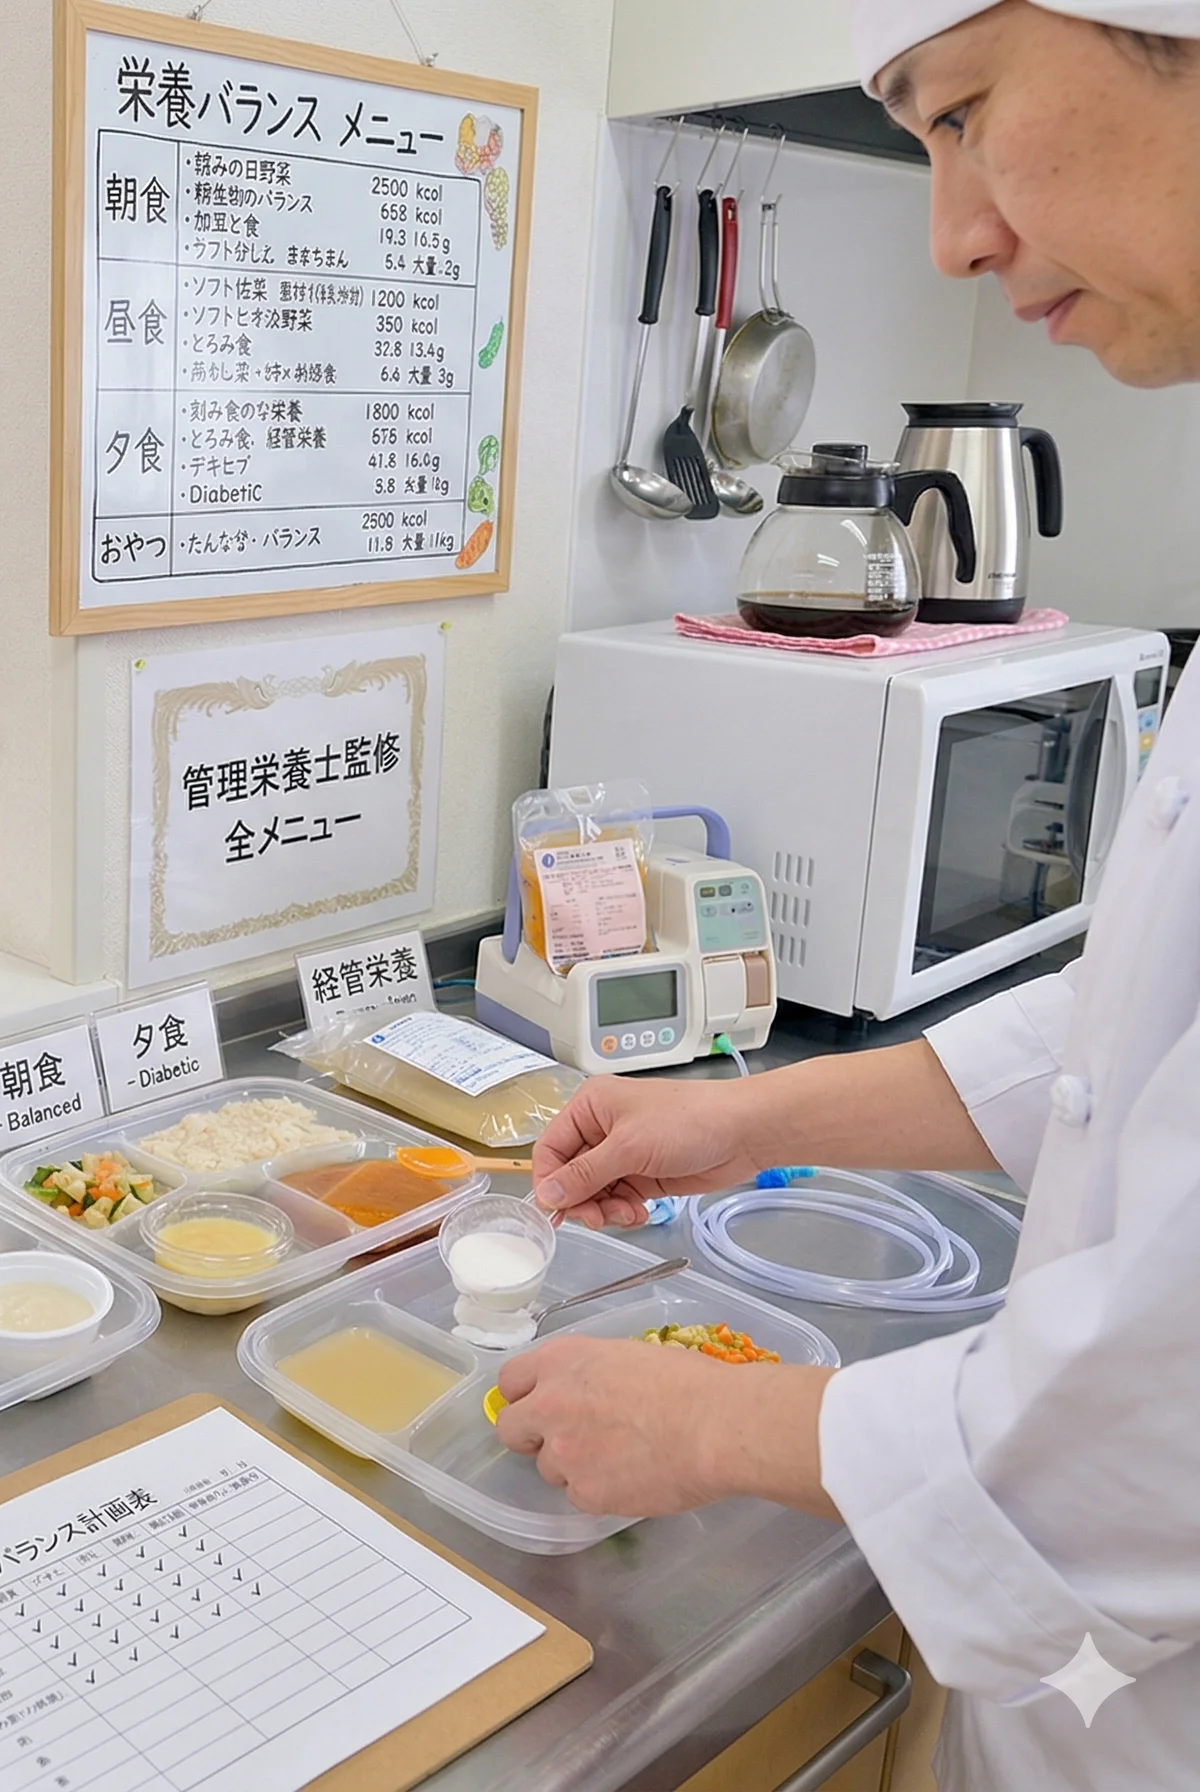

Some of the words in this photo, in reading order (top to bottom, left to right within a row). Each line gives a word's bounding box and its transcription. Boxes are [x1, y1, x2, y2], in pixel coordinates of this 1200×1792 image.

[117, 55, 321, 142] 栄養バランス
[340, 102, 444, 155] メニュー
[105, 172, 170, 225] 朝食
[372, 176, 408, 197] 2500
[381, 203, 407, 221] 658
[380, 228, 406, 246] 19.3
[372, 289, 405, 308] 1200
[105, 298, 168, 347] 昼食
[376, 315, 403, 333] 350
[374, 340, 402, 357] 32.8
[438, 367, 454, 388] 3g
[366, 402, 399, 420] 1800
[105, 426, 166, 475] 夕食
[368, 452, 396, 469] 41.8
[100, 531, 167, 565] おやつ
[182, 731, 401, 811] 管理栄養士監修
[224, 813, 362, 864] 全メニュー
[312, 947, 418, 1004] 経管栄養
[132, 1013, 188, 1060] 夕食
[0, 1051, 66, 1101] 朝食
